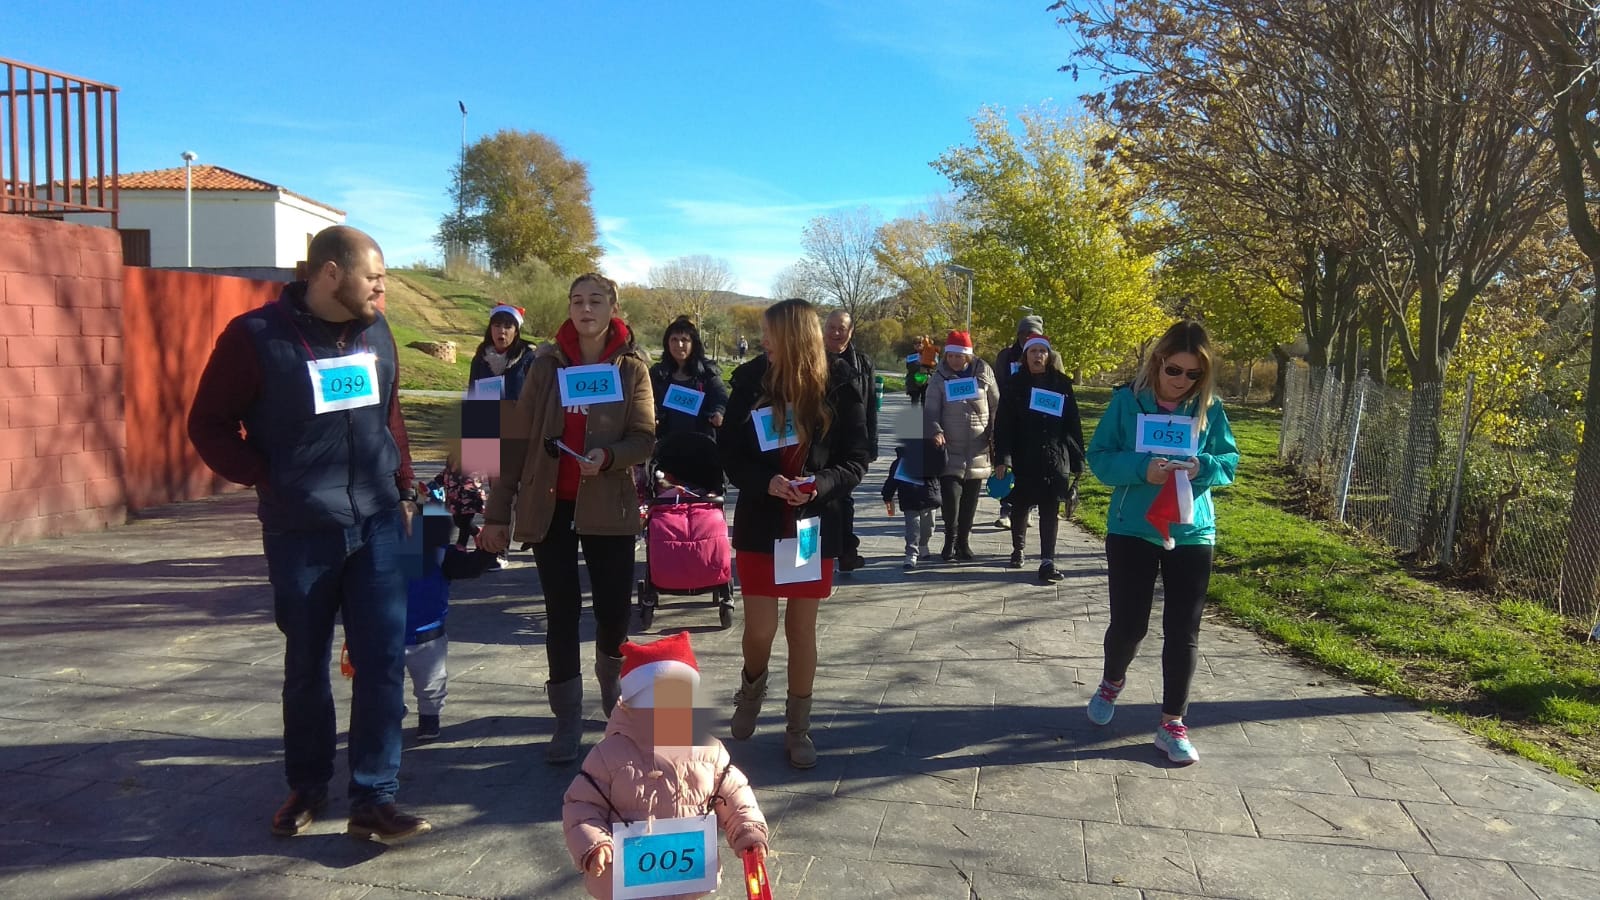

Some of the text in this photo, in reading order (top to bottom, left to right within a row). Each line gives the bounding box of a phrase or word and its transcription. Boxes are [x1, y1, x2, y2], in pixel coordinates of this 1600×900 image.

[331, 375, 365, 393] 039
[575, 378, 609, 393] 043
[674, 394, 696, 406] 038
[1153, 429, 1184, 444] 053
[638, 848, 695, 873] 005
